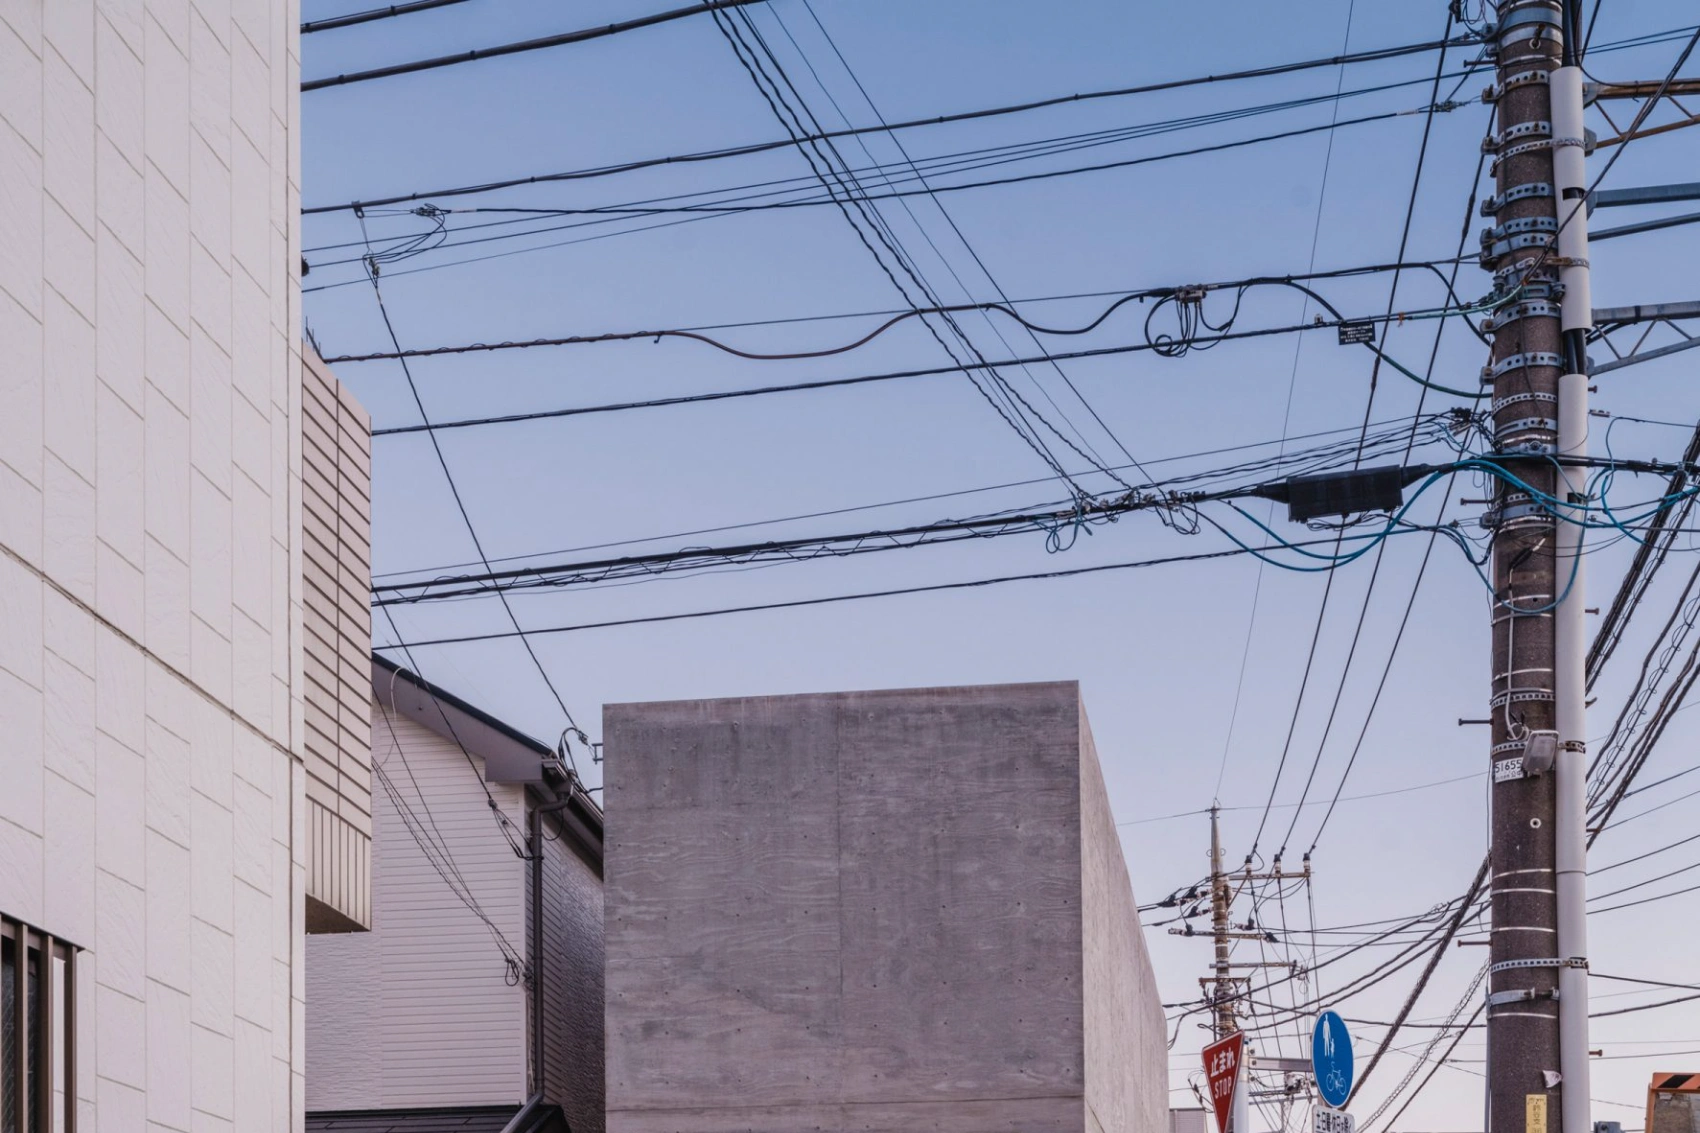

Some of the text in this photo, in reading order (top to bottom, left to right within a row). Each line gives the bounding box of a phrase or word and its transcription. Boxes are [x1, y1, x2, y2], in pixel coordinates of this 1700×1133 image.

[1210, 1046, 1236, 1078] 止まれ
[1214, 1076, 1232, 1100] STOP
